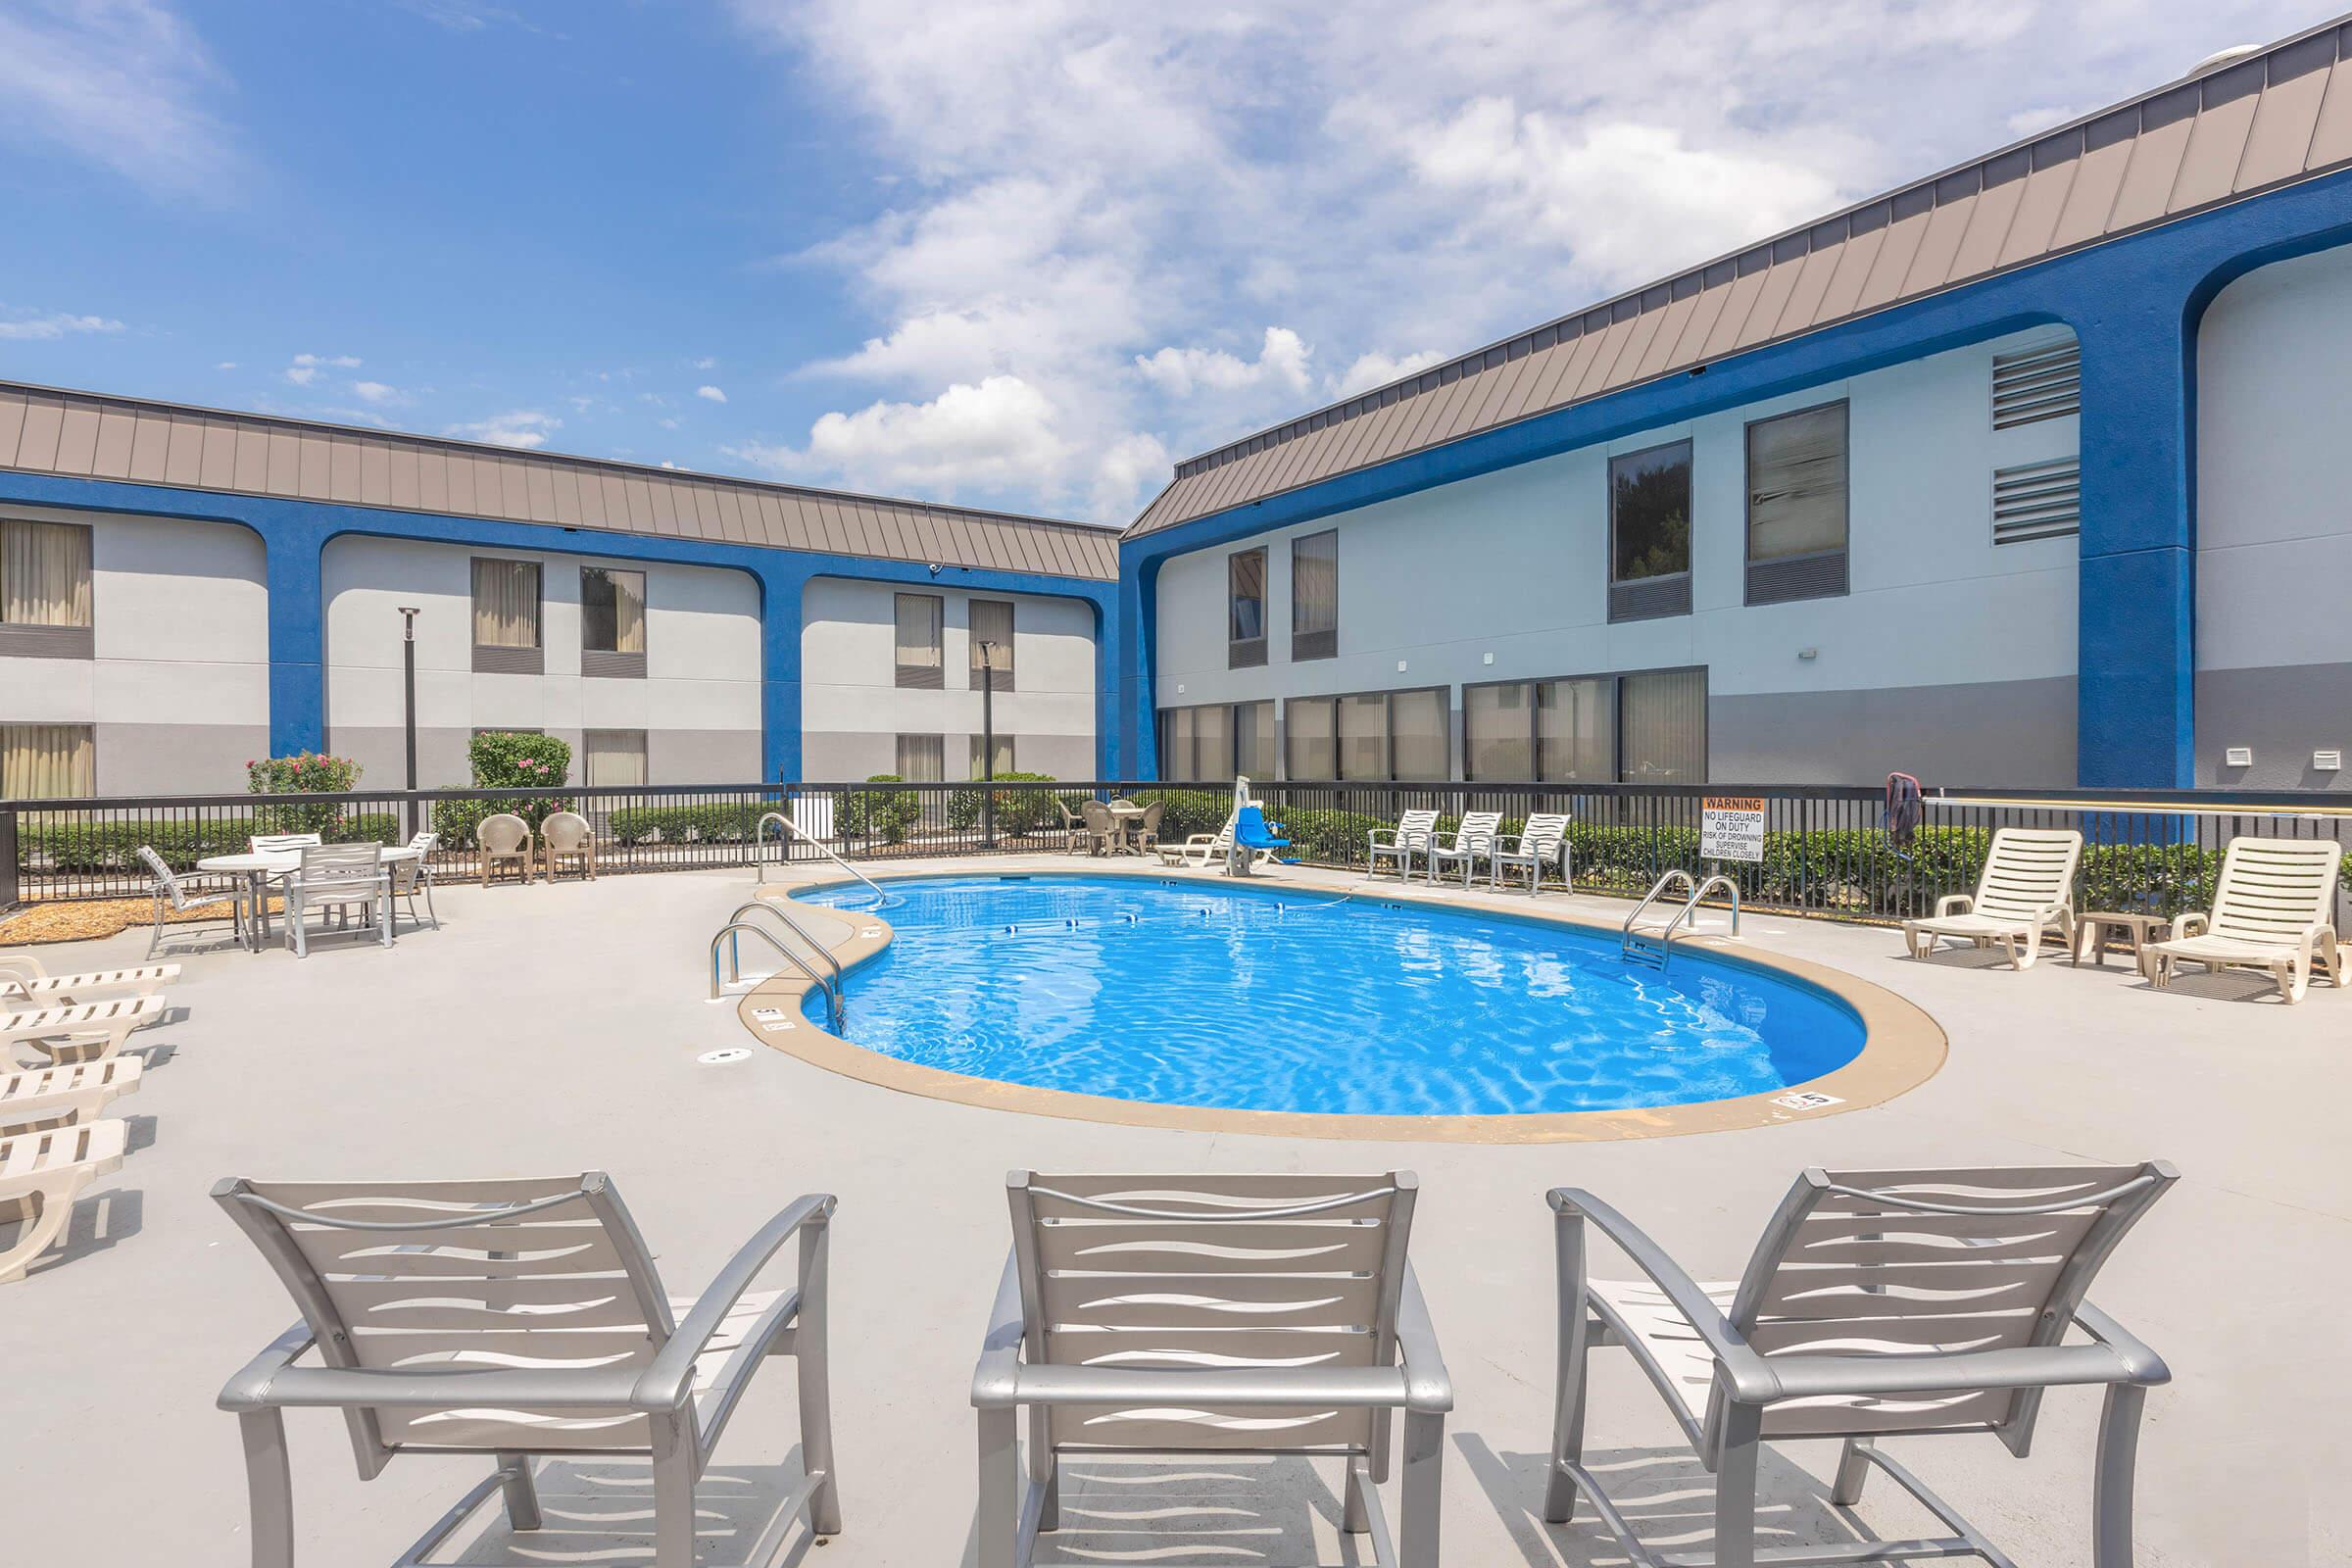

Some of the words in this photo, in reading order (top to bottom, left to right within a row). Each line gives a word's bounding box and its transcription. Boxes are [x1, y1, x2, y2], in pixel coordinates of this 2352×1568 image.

[1707, 799, 1760, 809] WARNING
[1705, 811, 1716, 820] NO
[1718, 811, 1761, 822] LIFEGUARD
[1716, 821, 1727, 830] ON
[1729, 822, 1749, 831] DUTY
[1728, 833, 1761, 842] DROWNING
[1716, 841, 1747, 850] SUPERVISE
[1703, 848, 1732, 857] CHILDREN
[1733, 850, 1759, 858] CLOSELY
